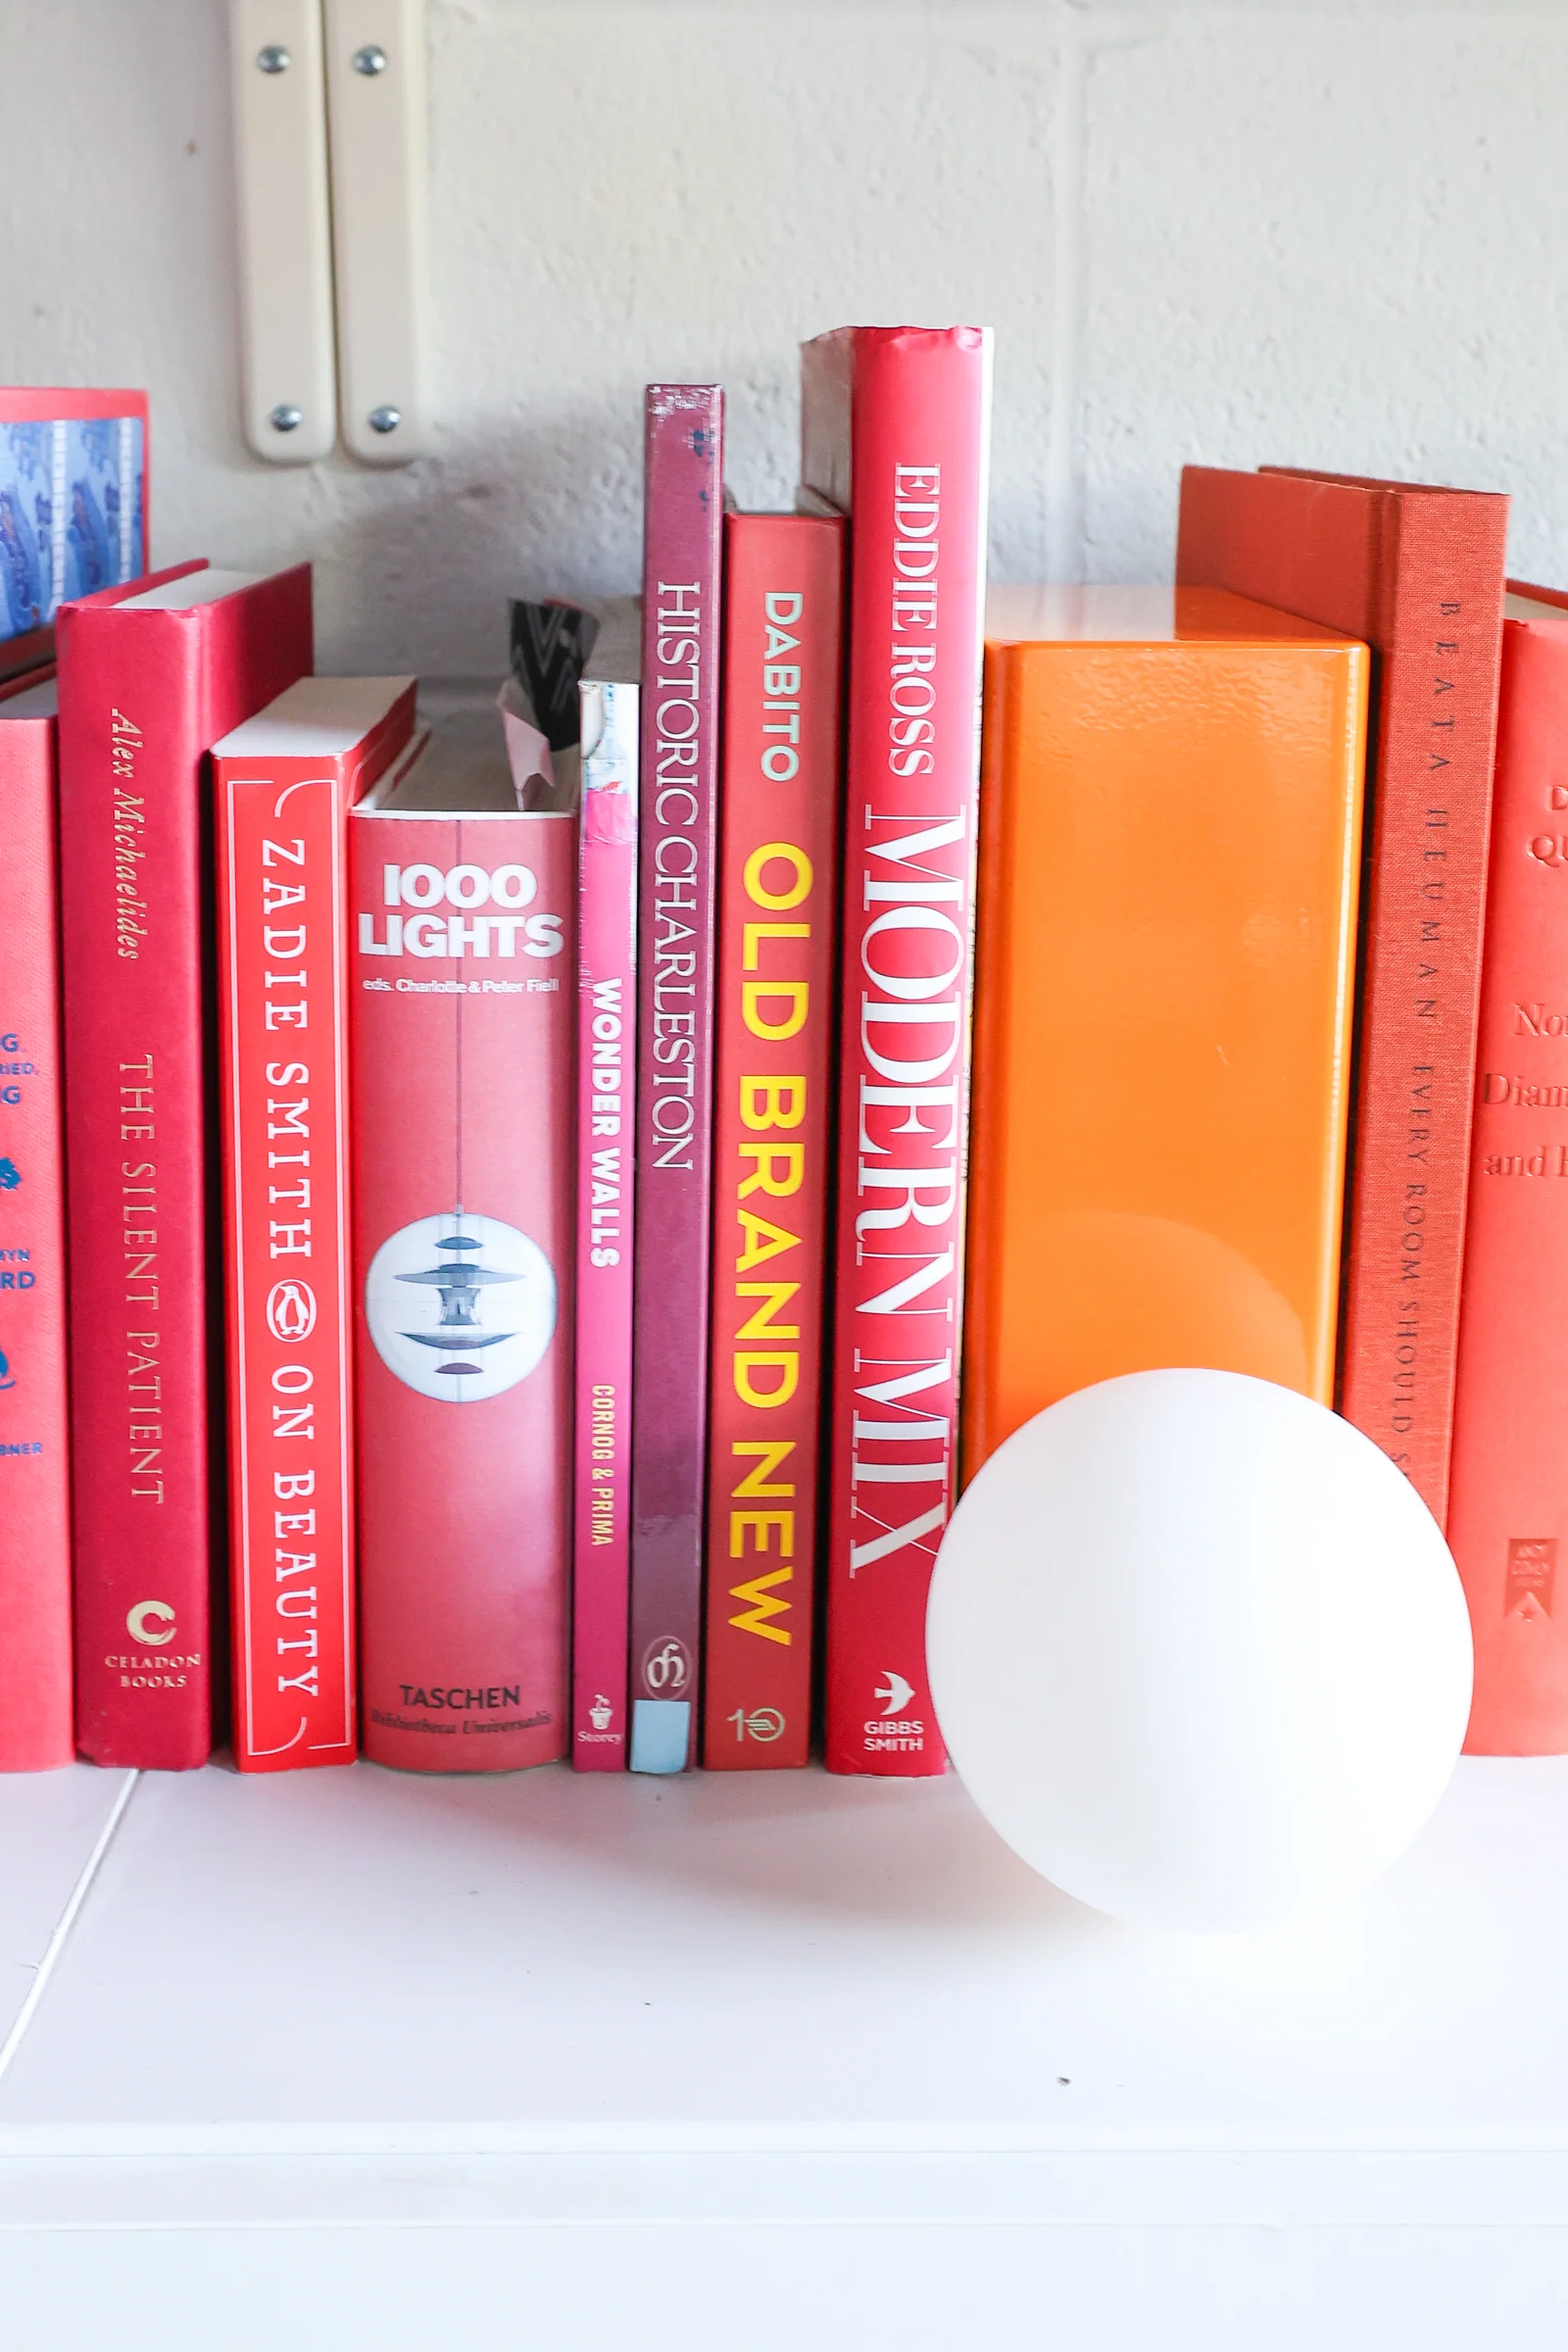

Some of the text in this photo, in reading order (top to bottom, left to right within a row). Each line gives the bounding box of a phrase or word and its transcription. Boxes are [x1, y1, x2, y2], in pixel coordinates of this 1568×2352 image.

[888, 463, 941, 777] EDDIE ROSS
[760, 592, 803, 782] DABITO
[1428, 603, 1460, 771] BEATA
[112, 708, 148, 959] Alex Michaelides
[383, 863, 538, 908] 1000
[652, 581, 701, 1170] HISTORIC CHARLESTON
[358, 912, 564, 958] LIGHTS
[1415, 808, 1448, 1017] HEUMAN
[262, 839, 312, 1259] ZADIE SMITH
[363, 977, 394, 993] eds.
[396, 978, 467, 994] Charlotte
[467, 980, 481, 994] &
[481, 980, 524, 994] Peter
[0, 1086, 21, 1104] G
[590, 977, 623, 1267] WONDER WALLS
[1406, 1065, 1434, 1163] EVERY
[1483, 1146, 1545, 1177] and
[727, 843, 813, 1646] OLD BRAND NEW
[849, 804, 966, 1579] MODERN MIX
[1399, 1184, 1427, 1281] ROOM
[119, 1054, 164, 1504] THE SILENT PATIENT
[1391, 1300, 1420, 1433] SHOULD
[271, 1364, 318, 1697] ON BEAUTY
[591, 1384, 615, 1545] CORNOG & PRIMA
[104, 1653, 201, 1669] CELADON
[120, 1675, 187, 1689] BOOKS
[400, 1685, 520, 1709] TASCHEN
[863, 1720, 924, 1735] GIBBS
[577, 1730, 622, 1745] Storey
[863, 1737, 924, 1751] SMITH
